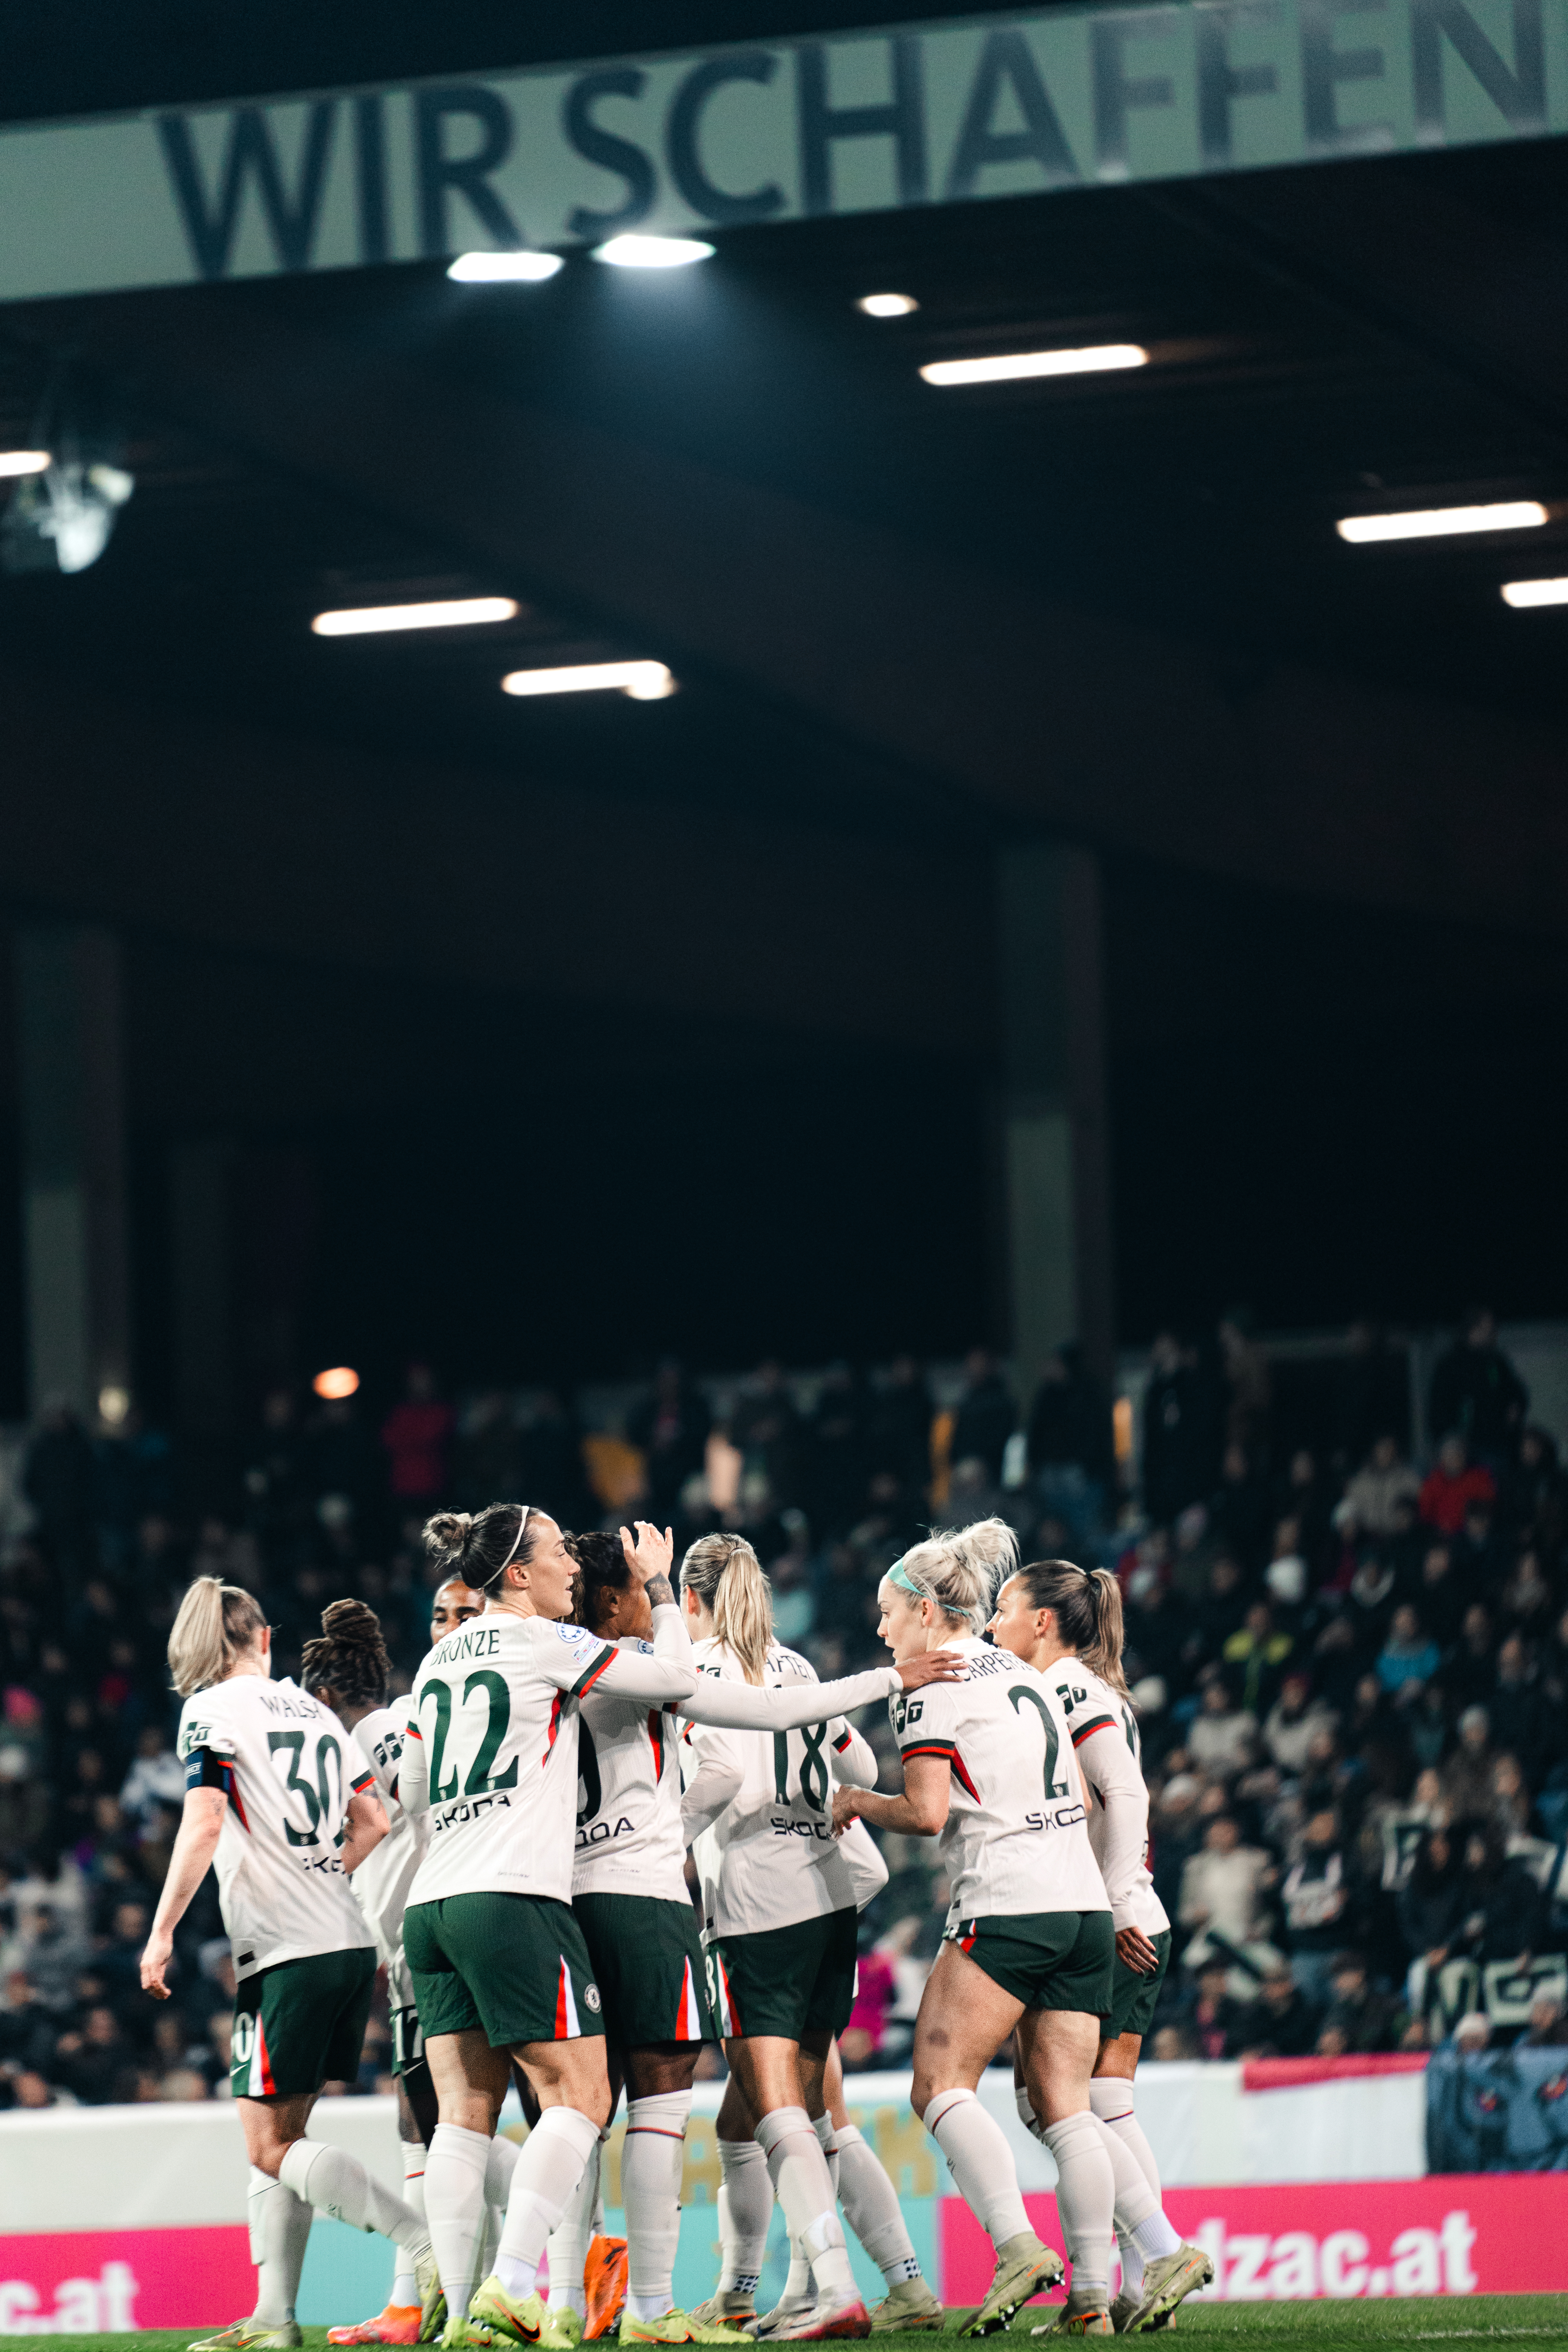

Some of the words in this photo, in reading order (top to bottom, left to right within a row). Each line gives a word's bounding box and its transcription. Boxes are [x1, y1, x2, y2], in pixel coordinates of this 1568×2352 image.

[157, 83, 525, 279] WIR
[430, 1629, 501, 1666] BRONZE
[266, 1731, 344, 1849] 30
[419, 1670, 519, 1806] 22
[773, 1684, 829, 1813] 18
[1007, 1685, 1070, 1800] 2
